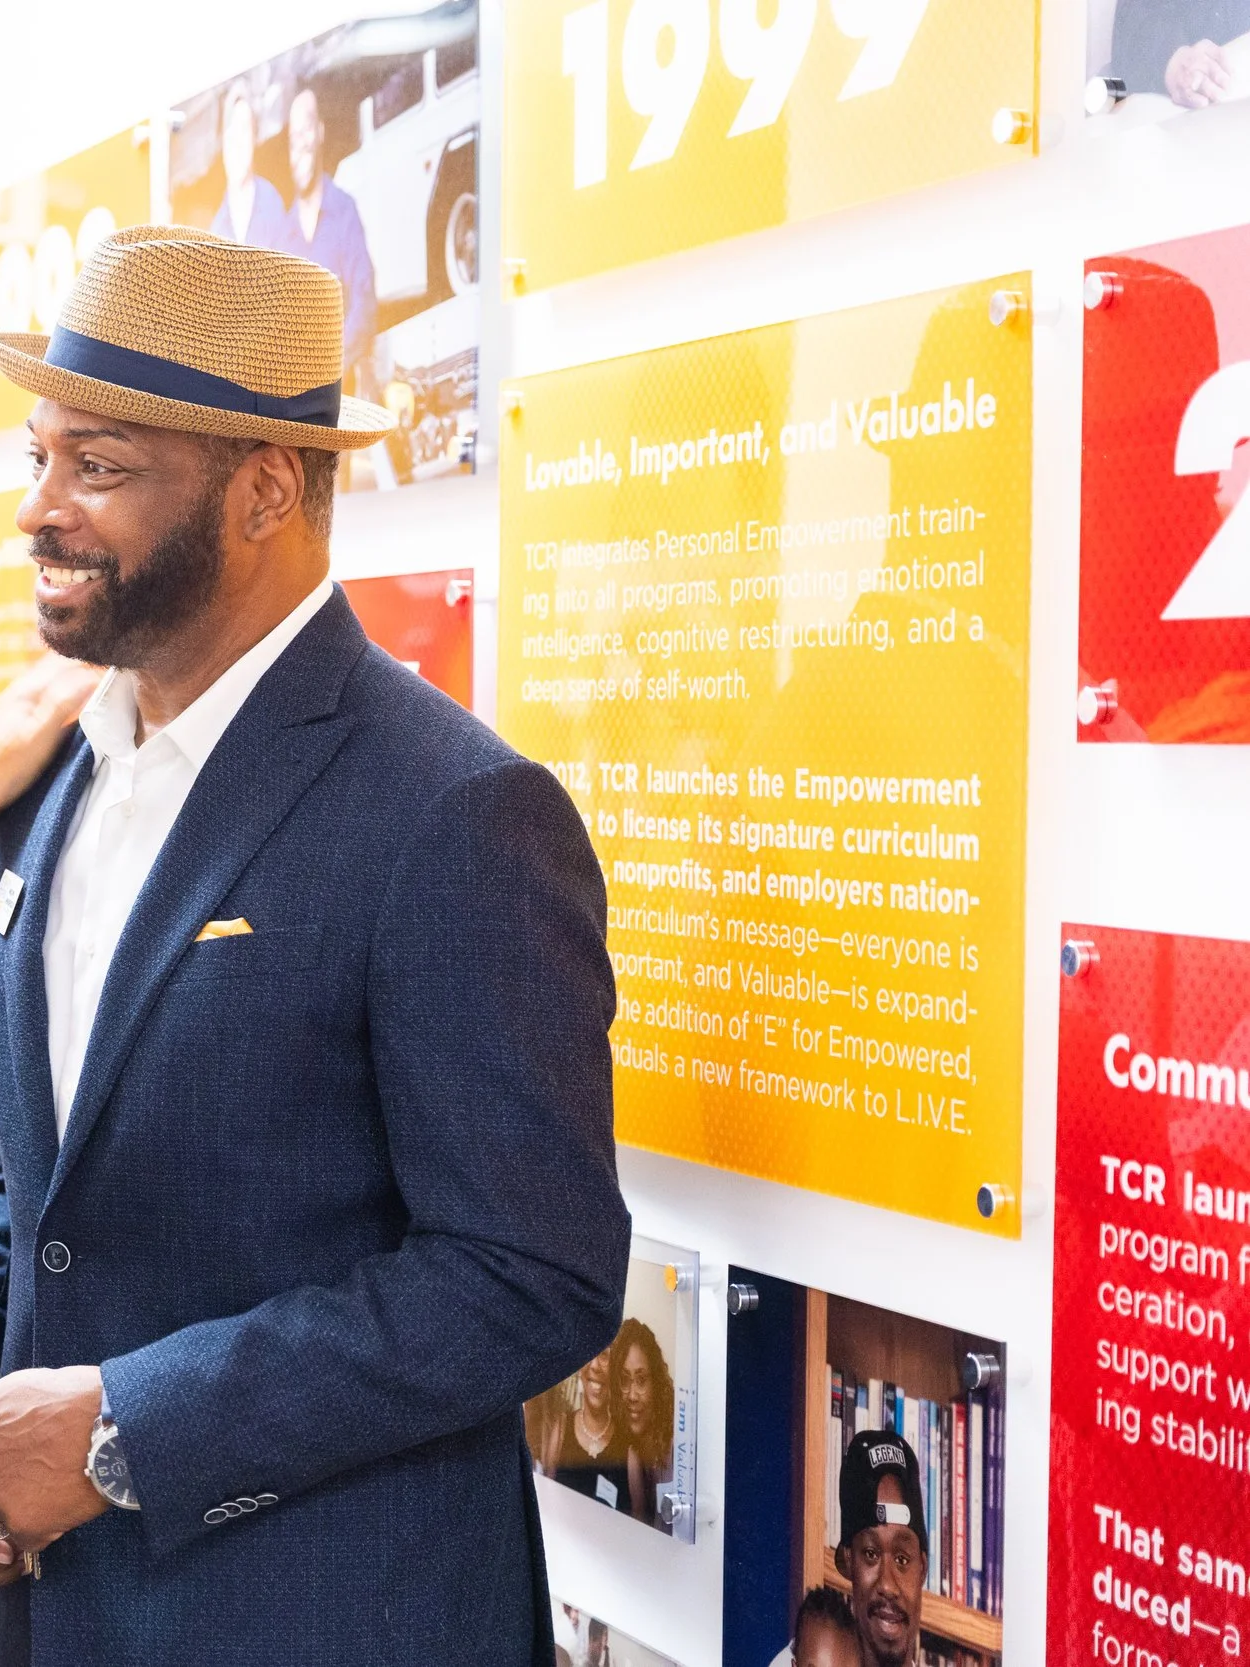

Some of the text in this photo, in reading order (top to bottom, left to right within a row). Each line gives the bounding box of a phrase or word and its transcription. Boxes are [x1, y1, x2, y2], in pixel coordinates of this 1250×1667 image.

[562, 0, 930, 190] 1999
[525, 378, 997, 492] Lovable, Important, and Valuable
[524, 499, 985, 572] TCR integrates Personal Empowerment train-
[523, 551, 984, 620] ing into all programs, promoting emotional
[523, 609, 984, 660] intelligence, cognitive restructuring, and a
[522, 666, 750, 705] deep sense of self-worth.
[599, 762, 638, 794] TCR
[647, 766, 738, 797] launches
[748, 767, 784, 799] the
[795, 768, 980, 807] Empowerment
[597, 810, 618, 837] to
[623, 808, 690, 842] license
[697, 815, 722, 843] its
[729, 815, 835, 853] signature
[843, 826, 979, 860] curriculum
[613, 861, 718, 895] nonprofits,
[722, 867, 760, 896] and
[766, 872, 883, 907] employers
[891, 882, 979, 916] nation-
[960, 936, 978, 971] is
[695, 958, 731, 990] and
[739, 963, 868, 1011] Valuable—is
[876, 978, 977, 1025] expand-
[645, 1000, 723, 1037] addition
[729, 1009, 750, 1042] of
[792, 1019, 822, 1053] for
[829, 1026, 977, 1084] Empowered,
[674, 1056, 685, 1077] a
[691, 1059, 732, 1087] new
[739, 1061, 855, 1112] framework
[864, 1083, 888, 1117] to
[896, 1088, 972, 1136] L.I.V.E.
[1100, 1155, 1166, 1206] TCR
[1099, 1222, 1228, 1281] program
[1098, 1281, 1235, 1351] ceration,
[1097, 1339, 1217, 1401] support
[678, 1401, 686, 1432] am
[1096, 1387, 1140, 1444] ing
[869, 1445, 906, 1466] LEGEND
[1093, 1504, 1250, 1597] That sam
